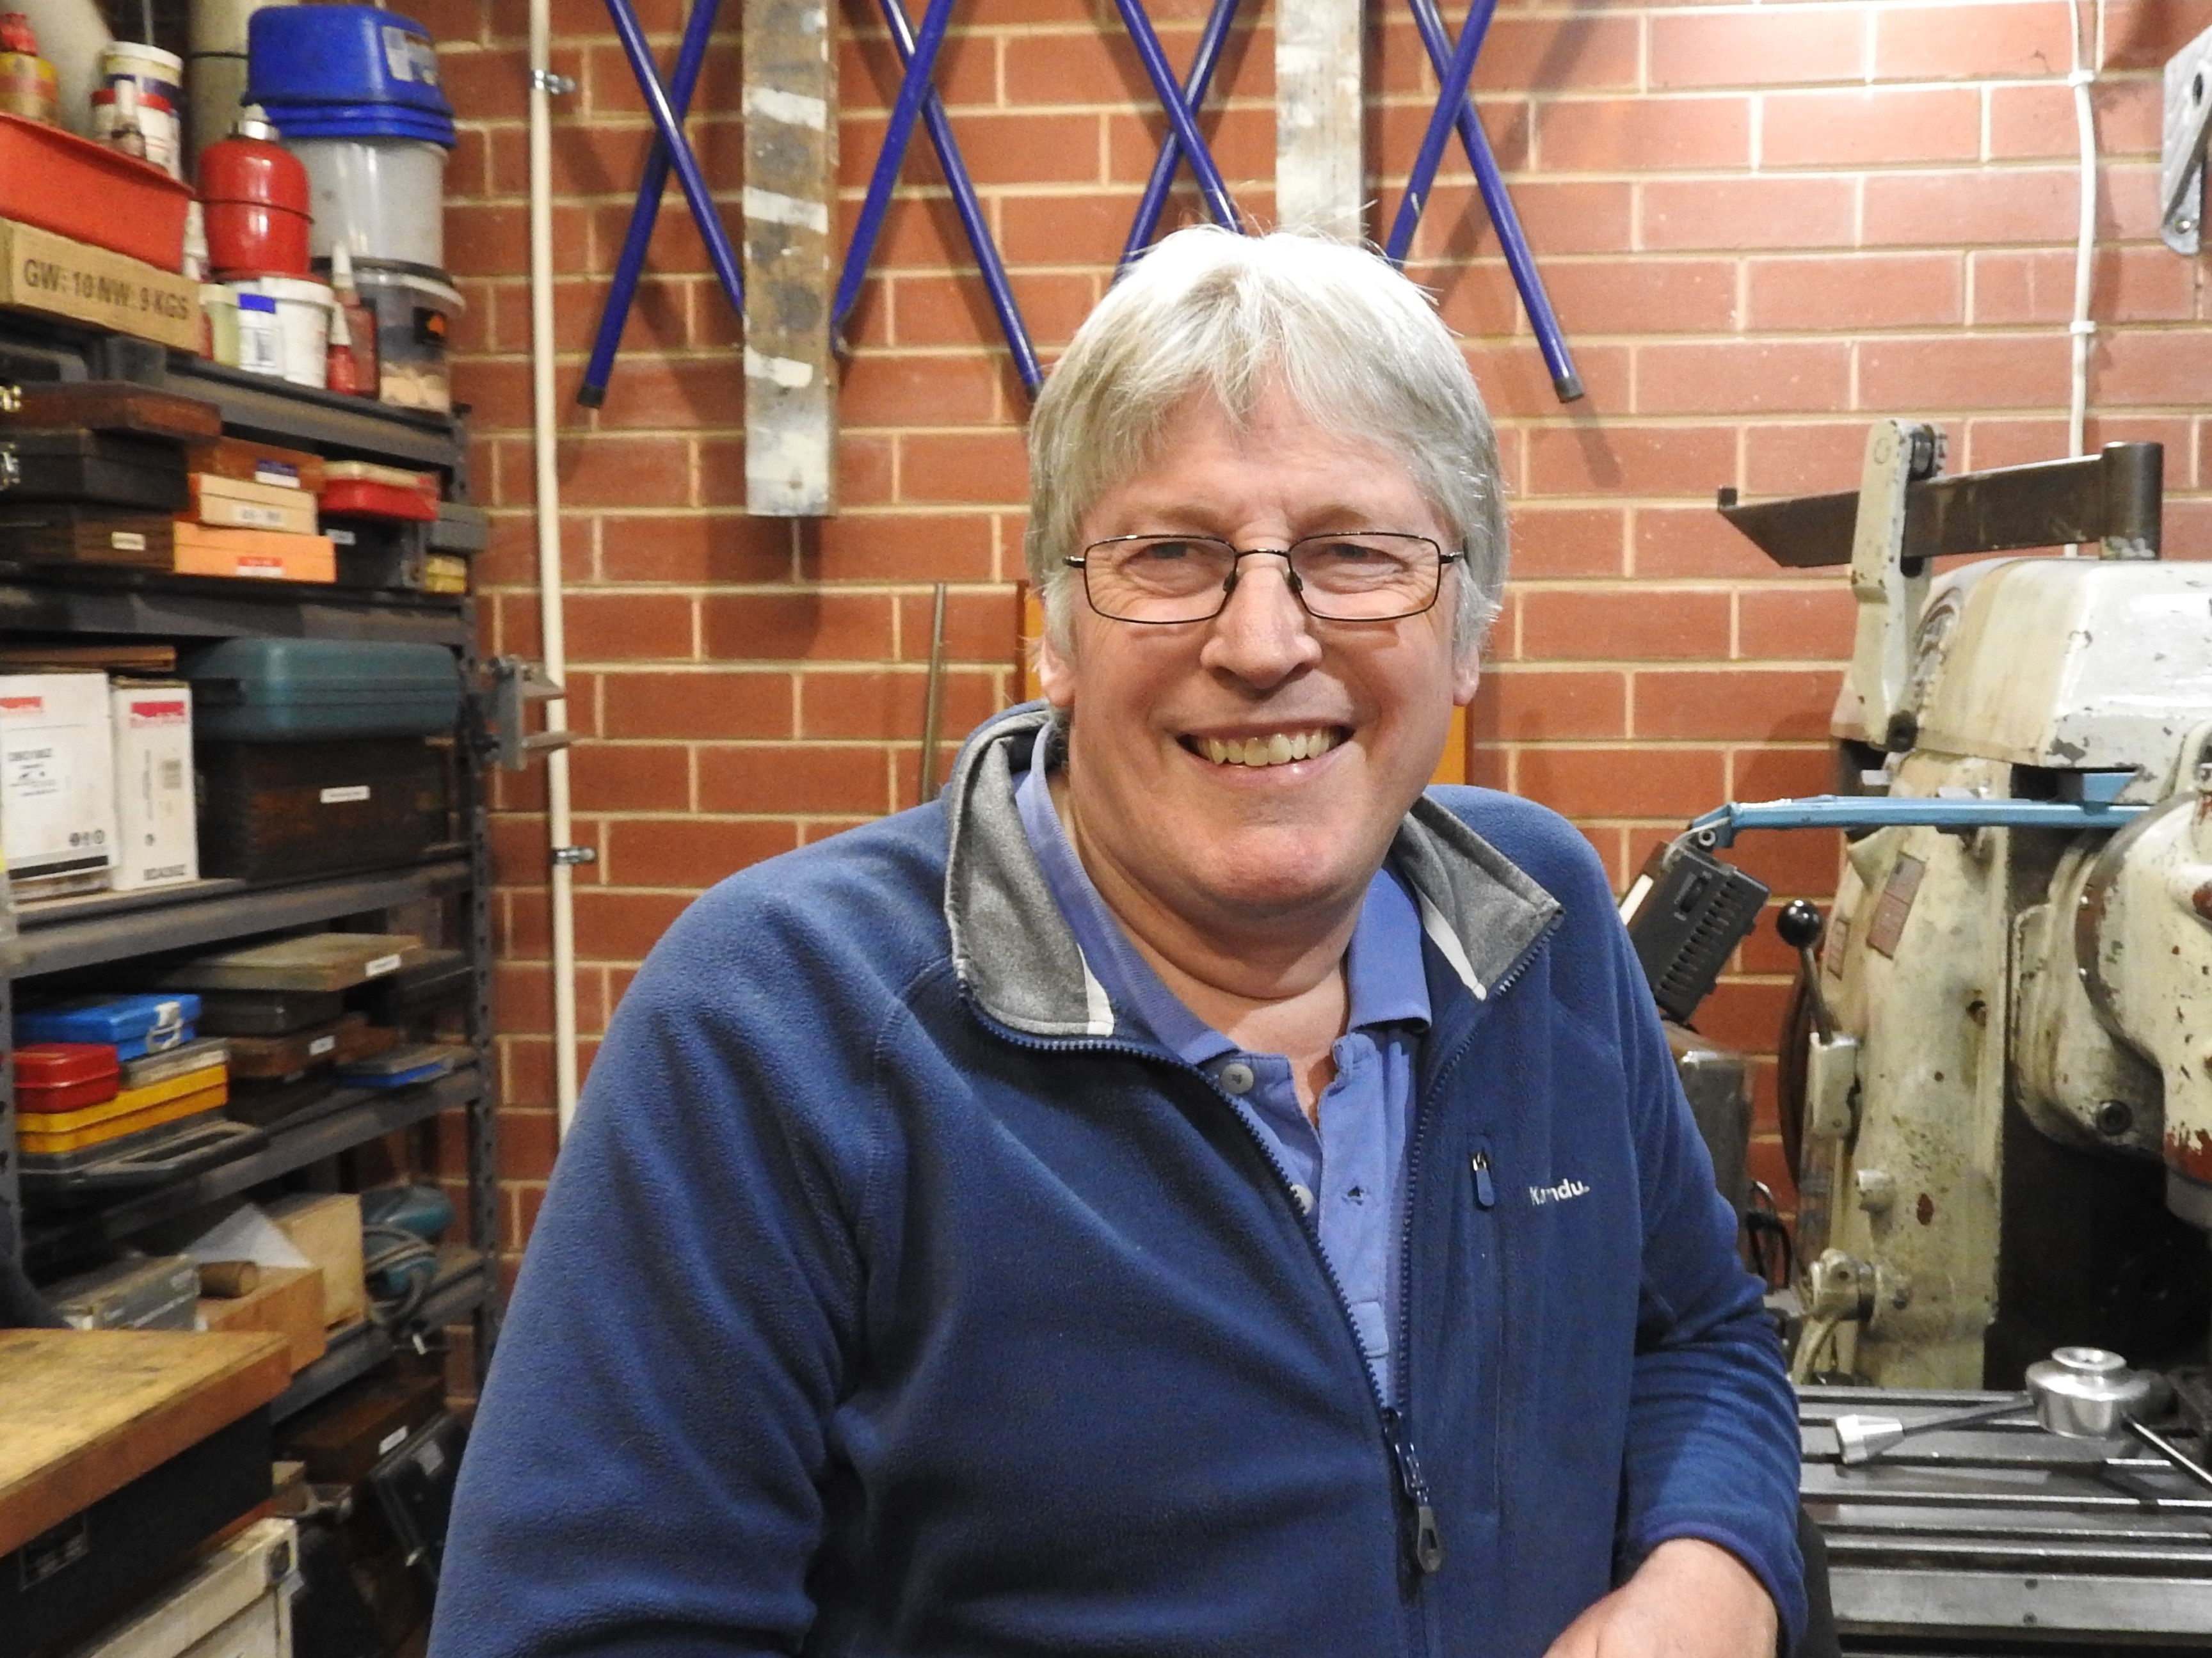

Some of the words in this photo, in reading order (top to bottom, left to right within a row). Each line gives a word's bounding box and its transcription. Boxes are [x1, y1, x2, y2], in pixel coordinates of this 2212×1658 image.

[72, 271, 93, 298] 10
[140, 287, 149, 311] 9
[154, 290, 188, 320] KGS
